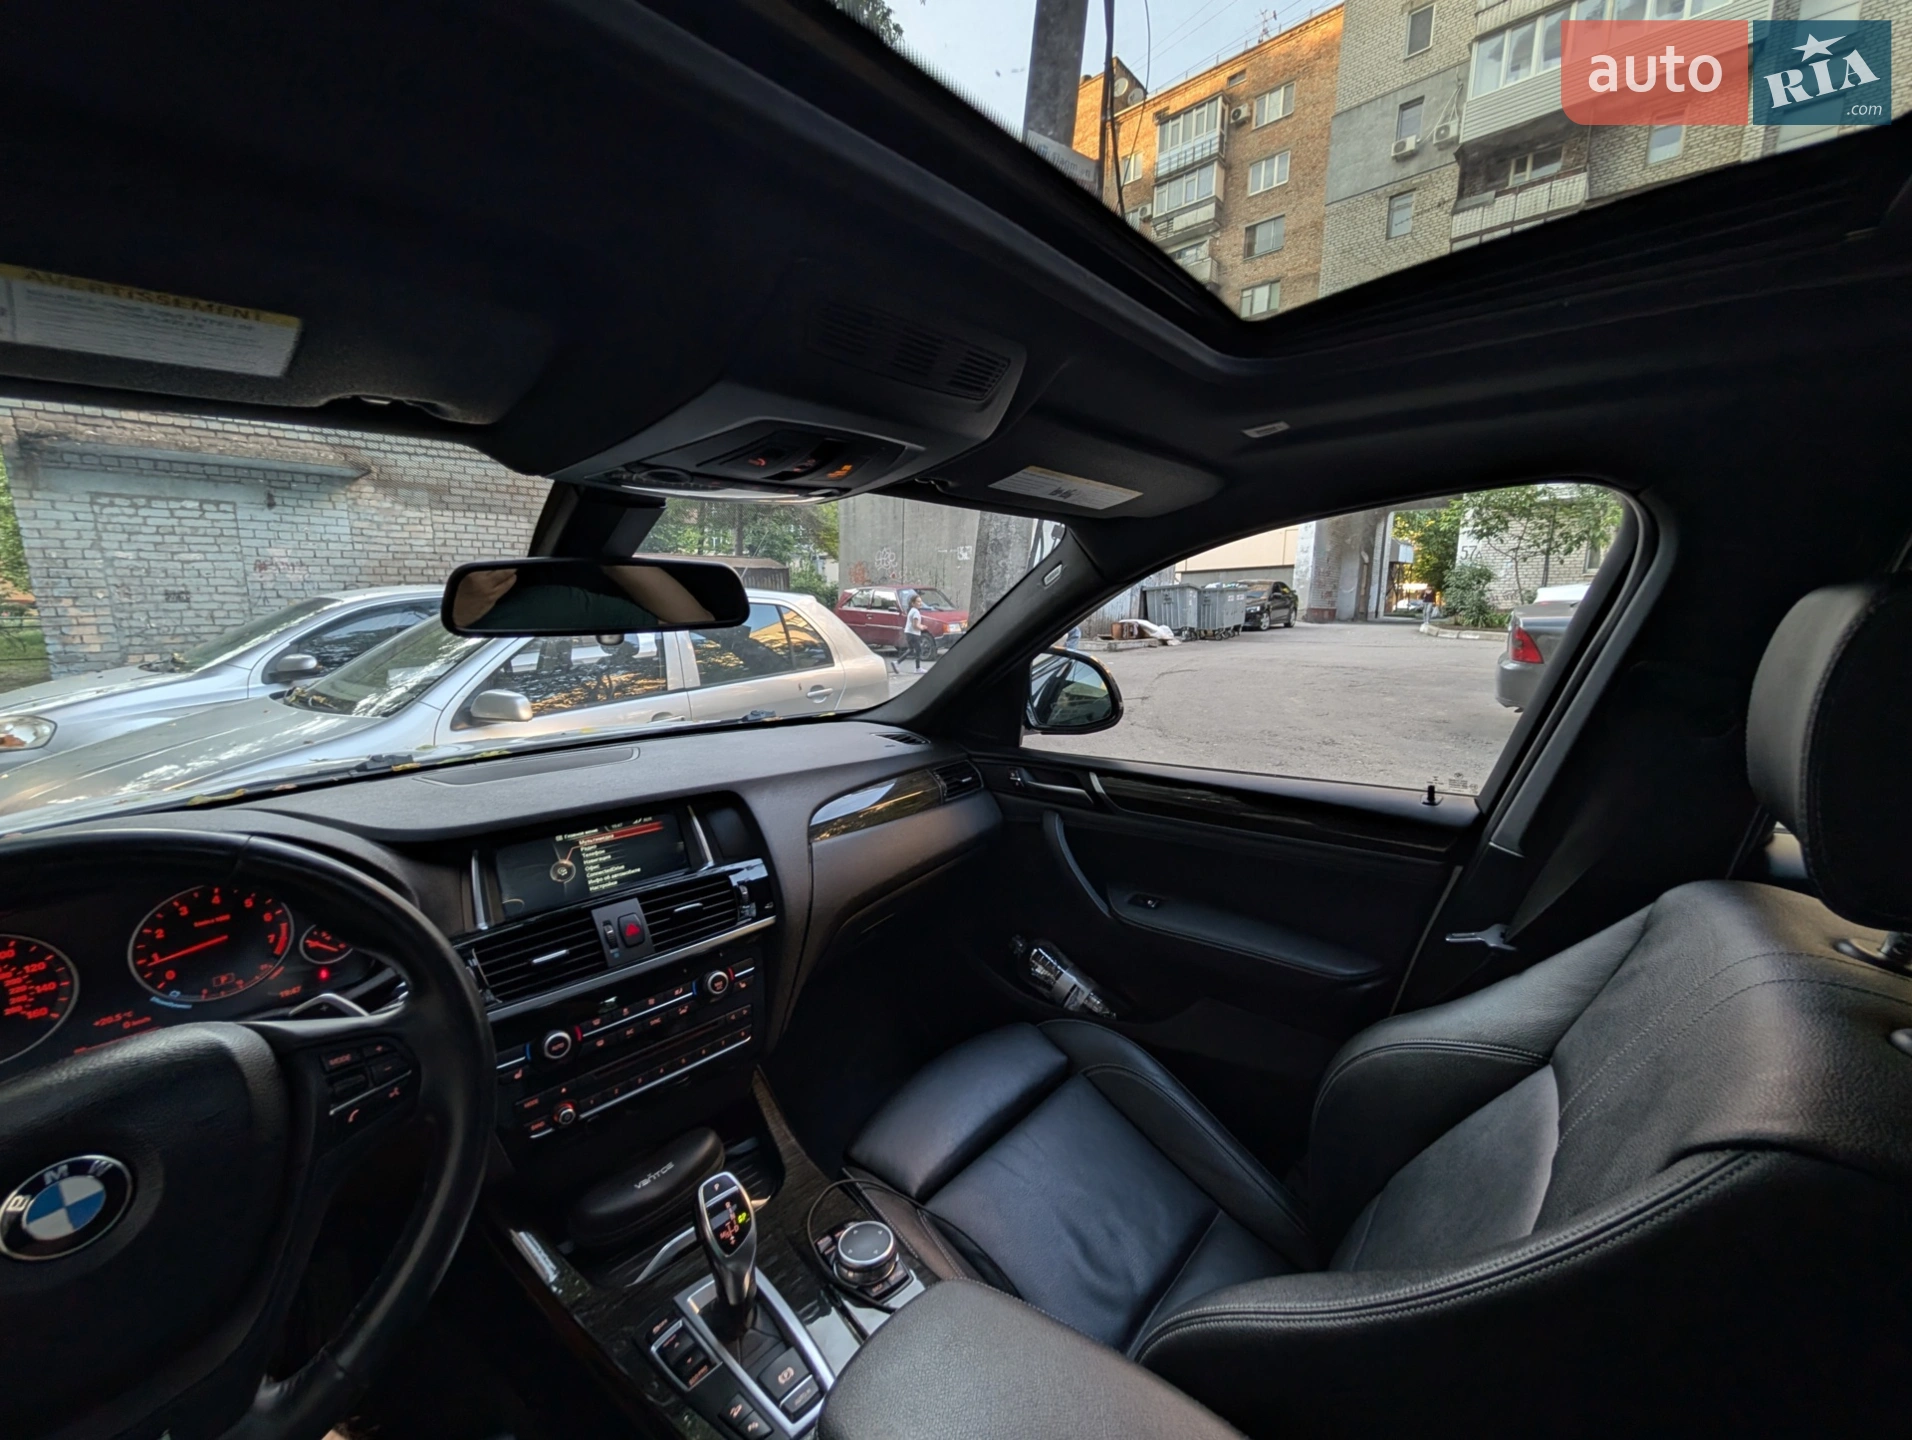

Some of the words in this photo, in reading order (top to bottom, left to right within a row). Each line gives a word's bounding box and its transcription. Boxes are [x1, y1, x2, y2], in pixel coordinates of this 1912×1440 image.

[178, 906, 189, 917] 3
[155, 928, 165, 939] 2
[268, 933, 276, 944] 7
[24, 961, 47, 973] 120
[165, 970, 176, 980] 0
[35, 981, 57, 993] 140
[6, 1159, 114, 1213] BMW
